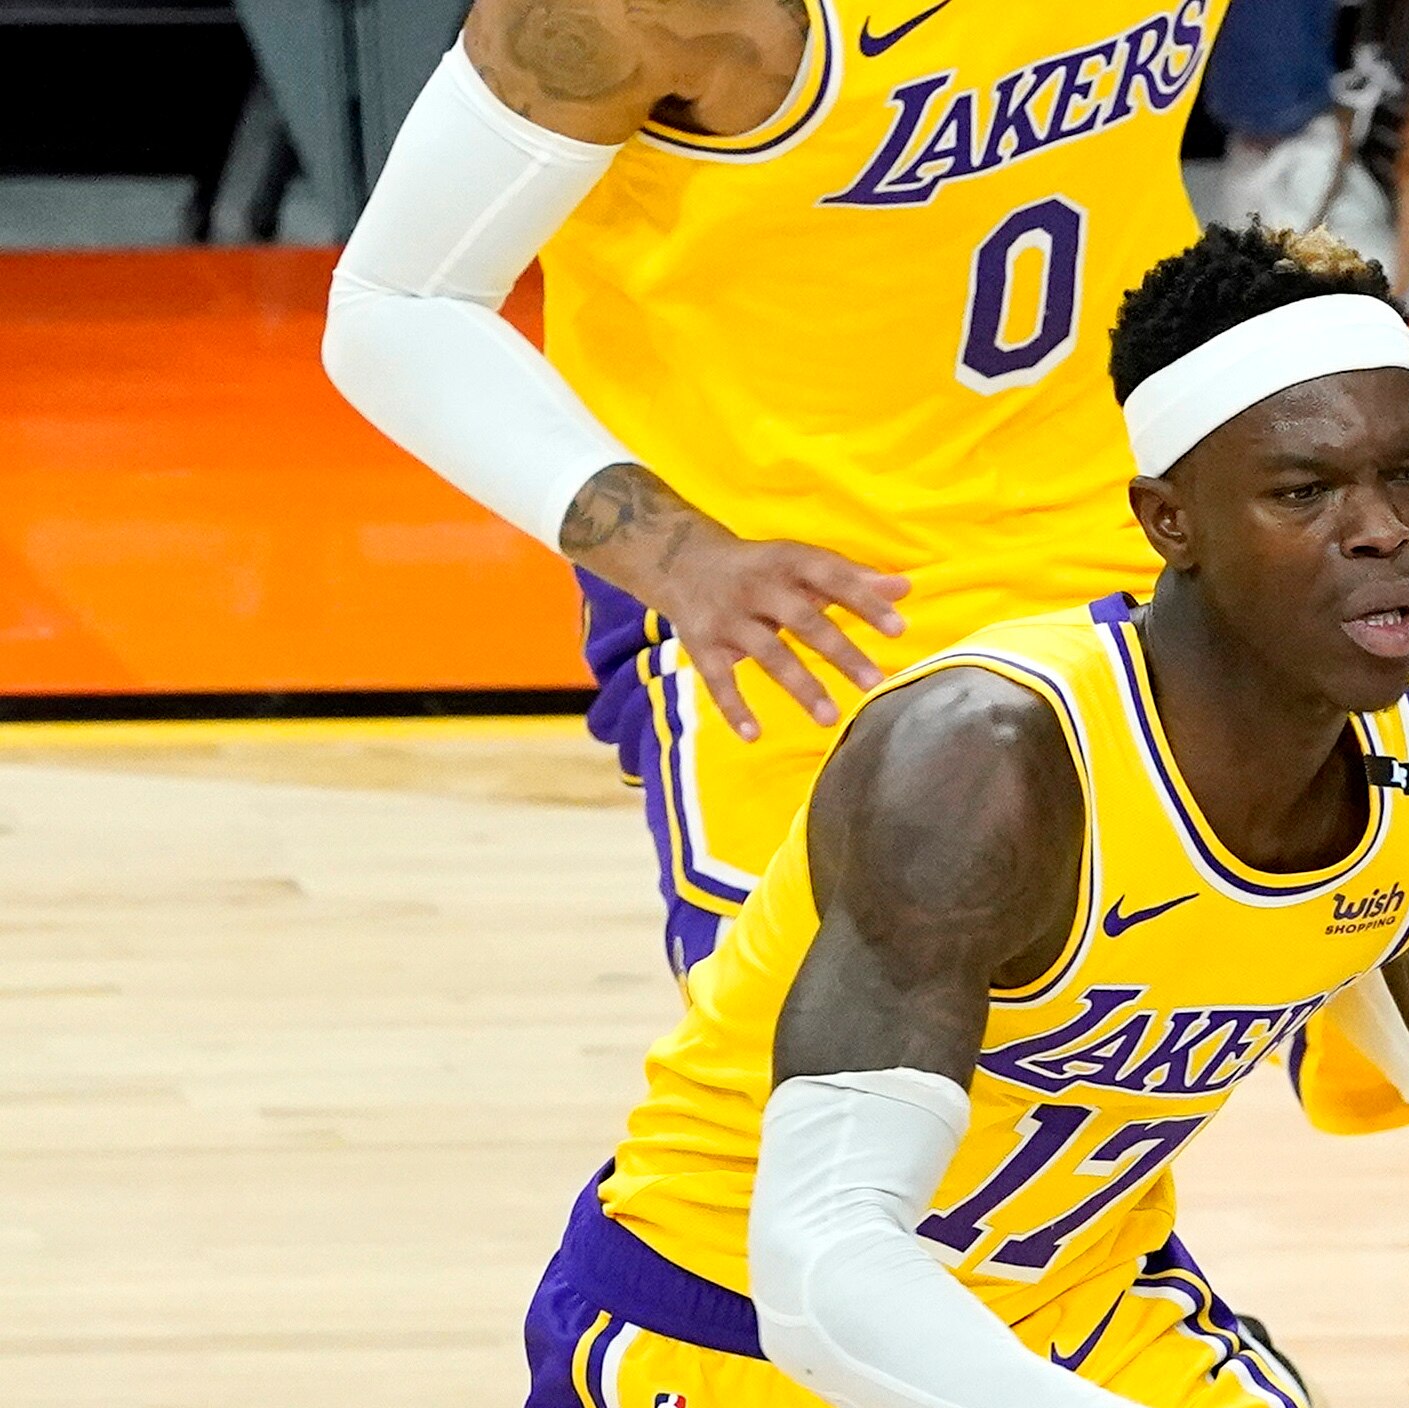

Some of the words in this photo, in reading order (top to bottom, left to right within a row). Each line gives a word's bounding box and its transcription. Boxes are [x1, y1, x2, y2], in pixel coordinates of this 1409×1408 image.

[817, 0, 1204, 207] LAKERS
[956, 194, 1088, 396] 0
[1325, 916, 1396, 935] SHOPPING
[1333, 882, 1405, 920] wish
[914, 1100, 1215, 1285] 17
